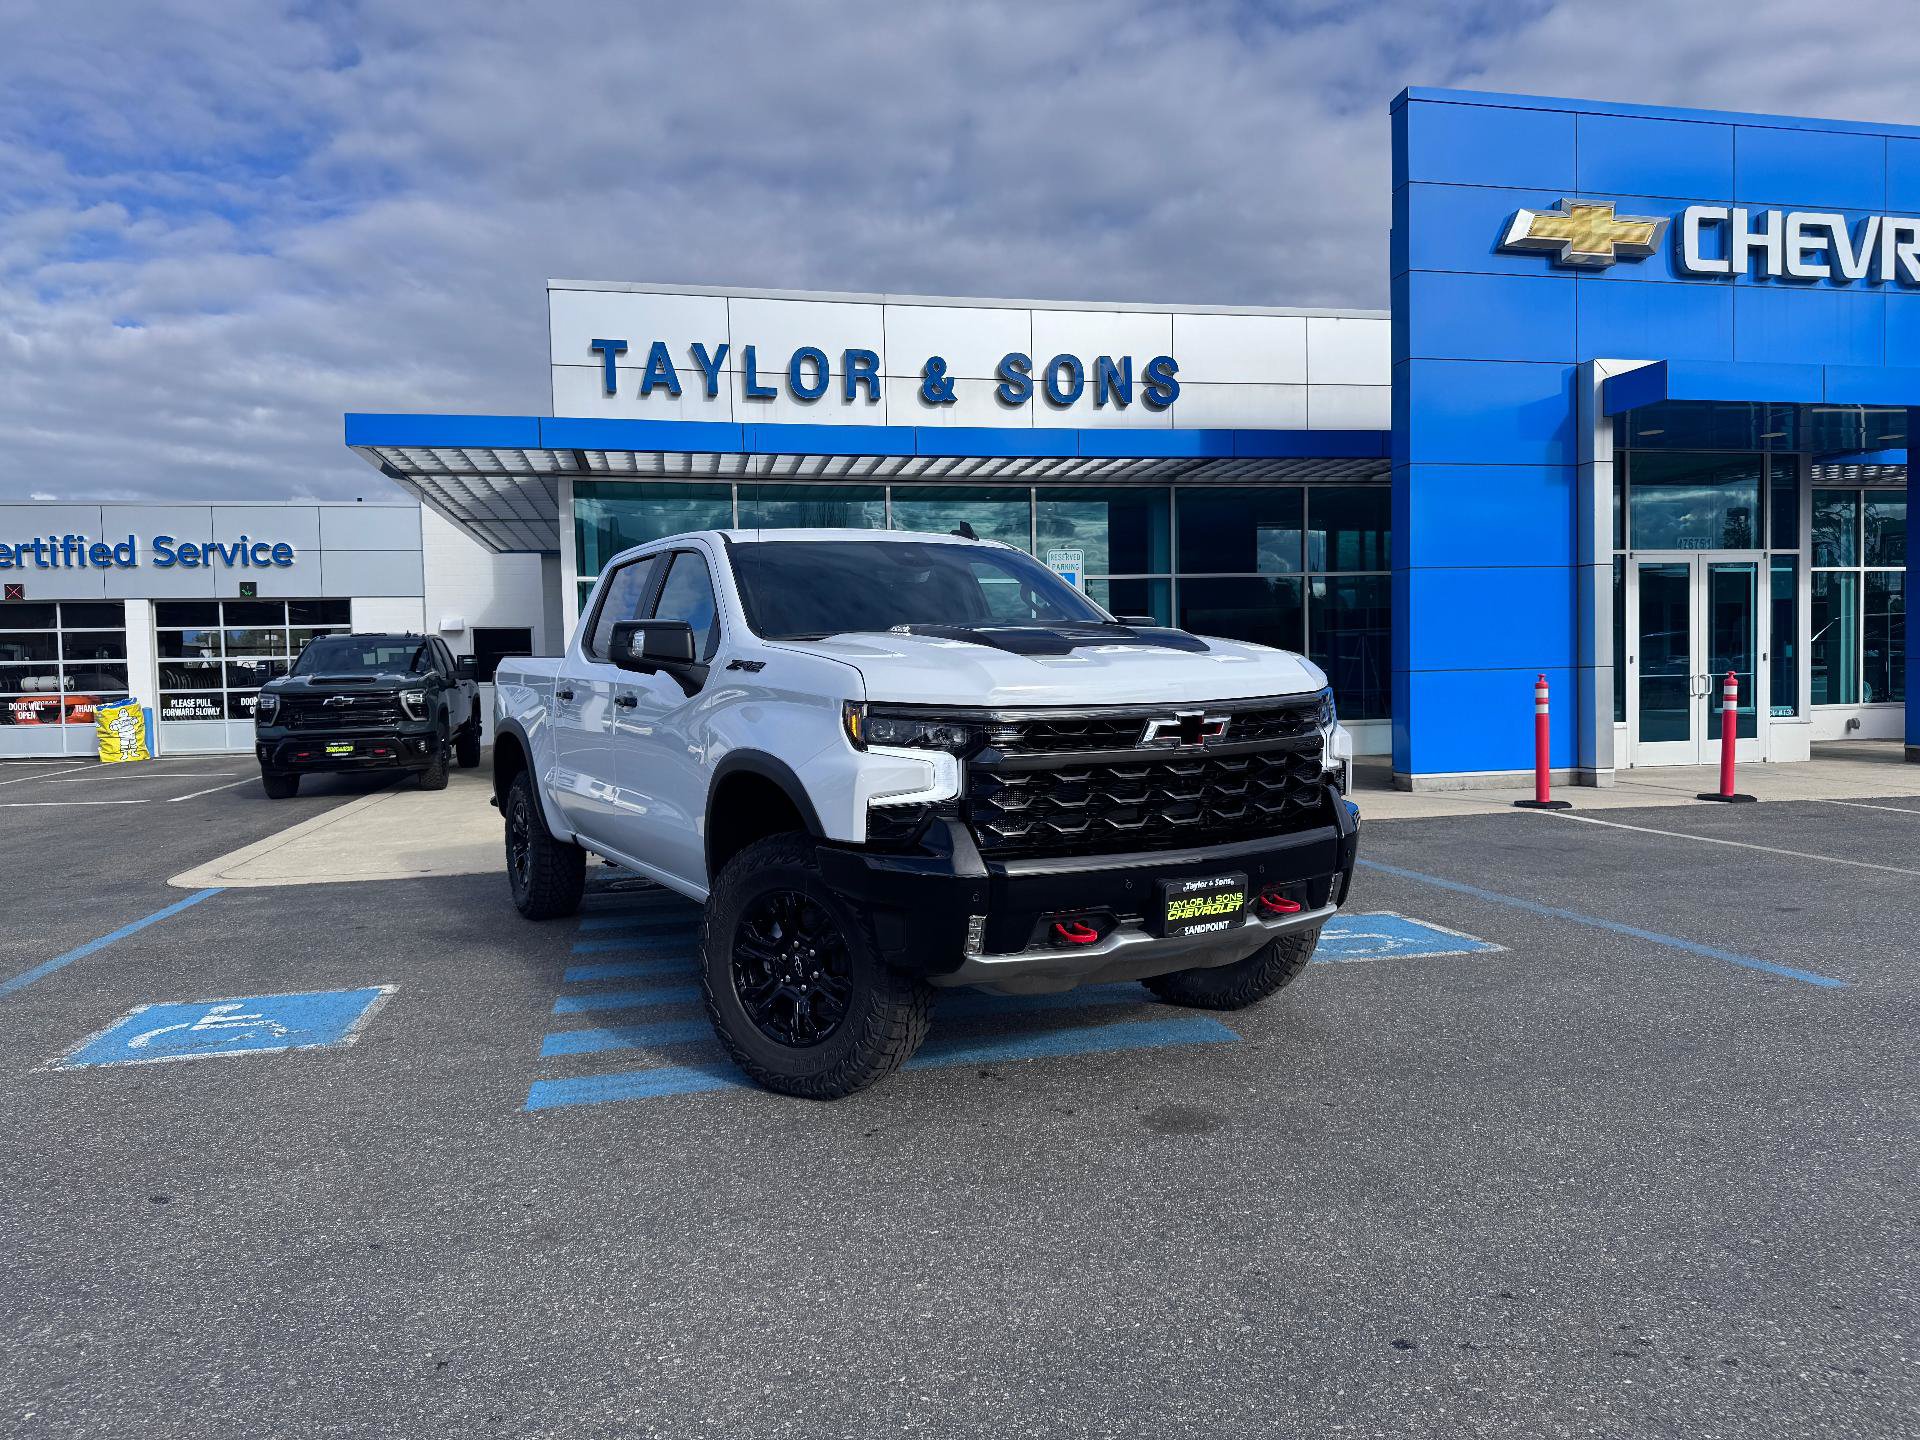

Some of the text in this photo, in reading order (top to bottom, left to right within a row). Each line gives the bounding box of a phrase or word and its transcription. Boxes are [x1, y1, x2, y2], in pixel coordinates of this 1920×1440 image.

[1683, 205, 1920, 283] CHEVR
[591, 339, 1180, 407] TAYLOR & SONS
[152, 535, 294, 568] Service
[1050, 553, 1081, 561] RESERVED
[1052, 563, 1080, 571] PARKING
[8, 701, 45, 711] DOOR WILL
[171, 698, 213, 708] PLEASE PULL
[18, 711, 36, 720] OPEN
[162, 707, 221, 717] FORWARD SLOWLY
[1185, 881, 1208, 891] Taylor
[1215, 878, 1232, 886] Sons
[1168, 892, 1243, 910] TAYLOR & SONS
[1167, 901, 1244, 921] CHEVROLET
[1184, 920, 1229, 935] SANDPOINT
